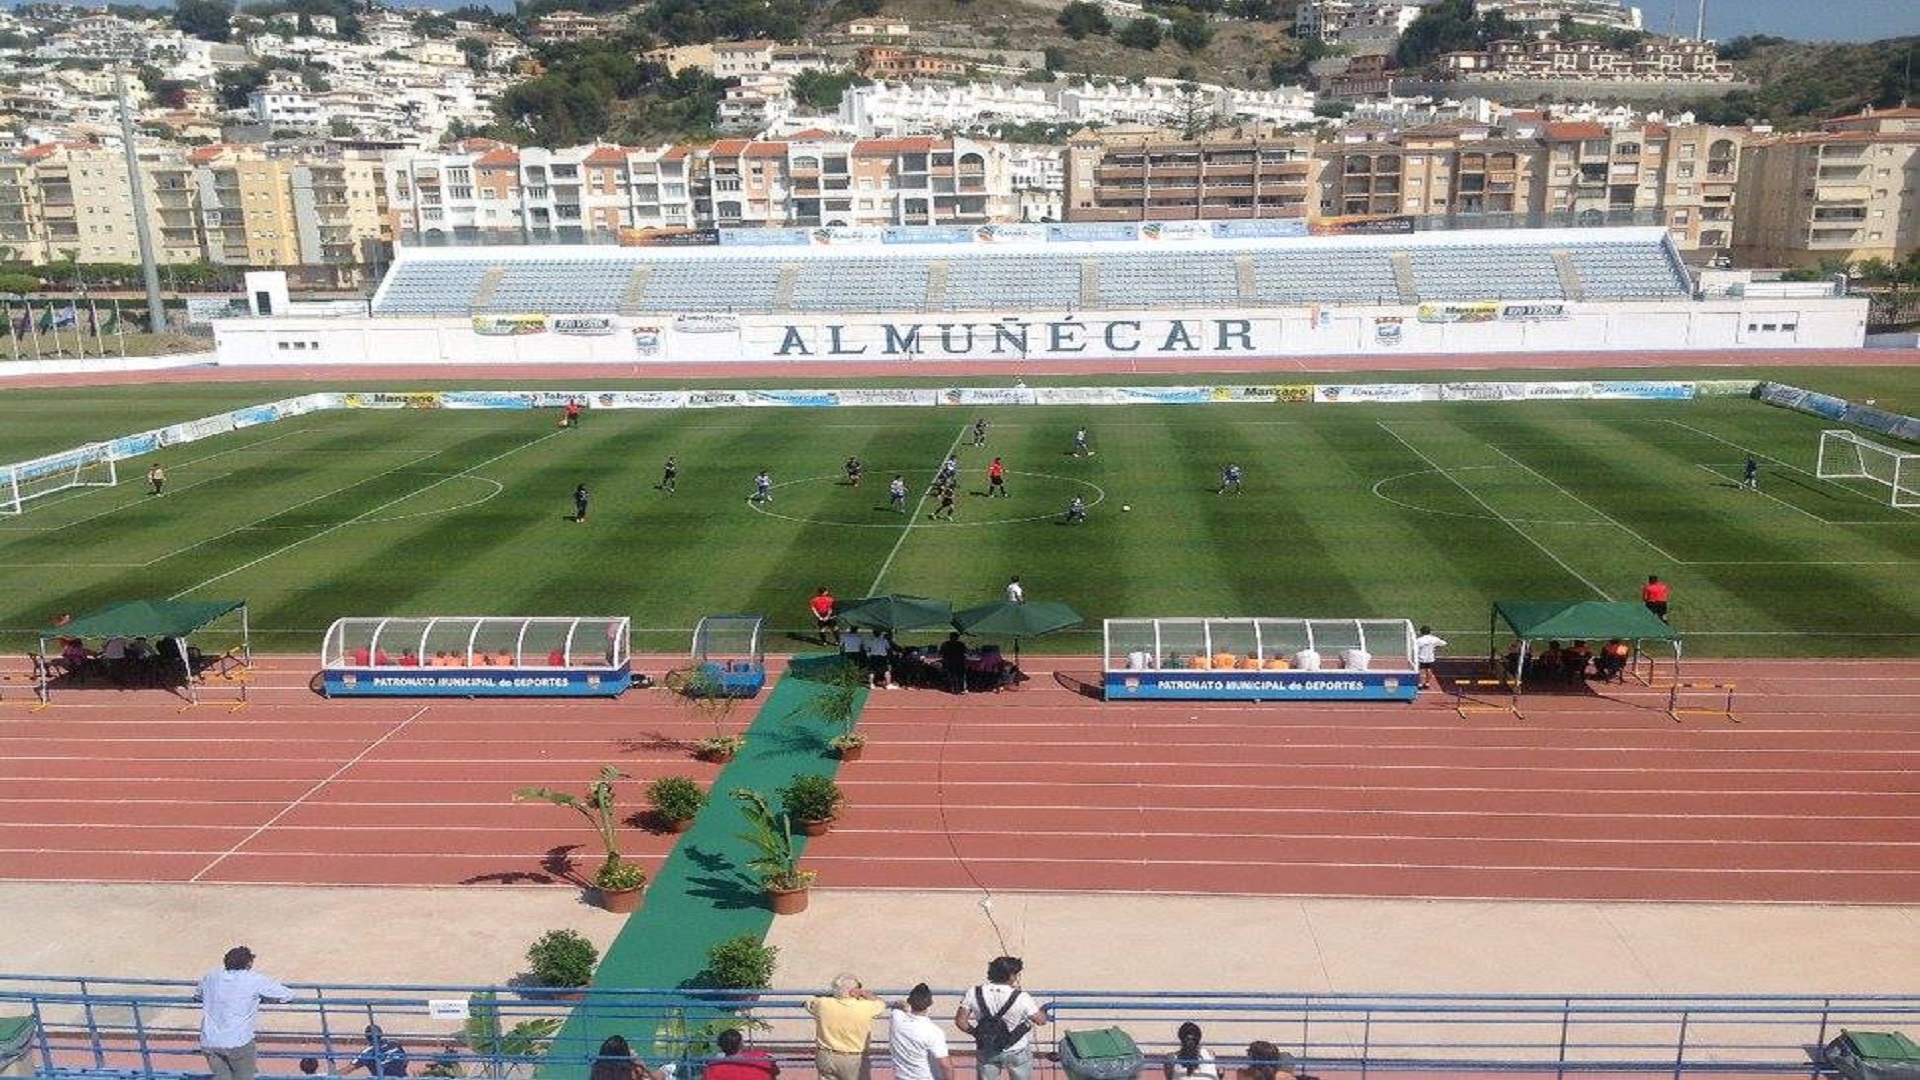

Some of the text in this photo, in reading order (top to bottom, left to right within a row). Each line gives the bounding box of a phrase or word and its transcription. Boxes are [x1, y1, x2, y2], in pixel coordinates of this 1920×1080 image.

[773, 315, 1257, 356] ALMUÑÉCAR
[373, 677, 436, 687] PATRONATO
[438, 677, 496, 687] MUNICIPAL
[514, 677, 570, 687] DEPORTES
[1157, 680, 1224, 691] PATRONATO
[1225, 680, 1287, 691] MUNICIPAL
[1305, 680, 1364, 691] DEPORTES
